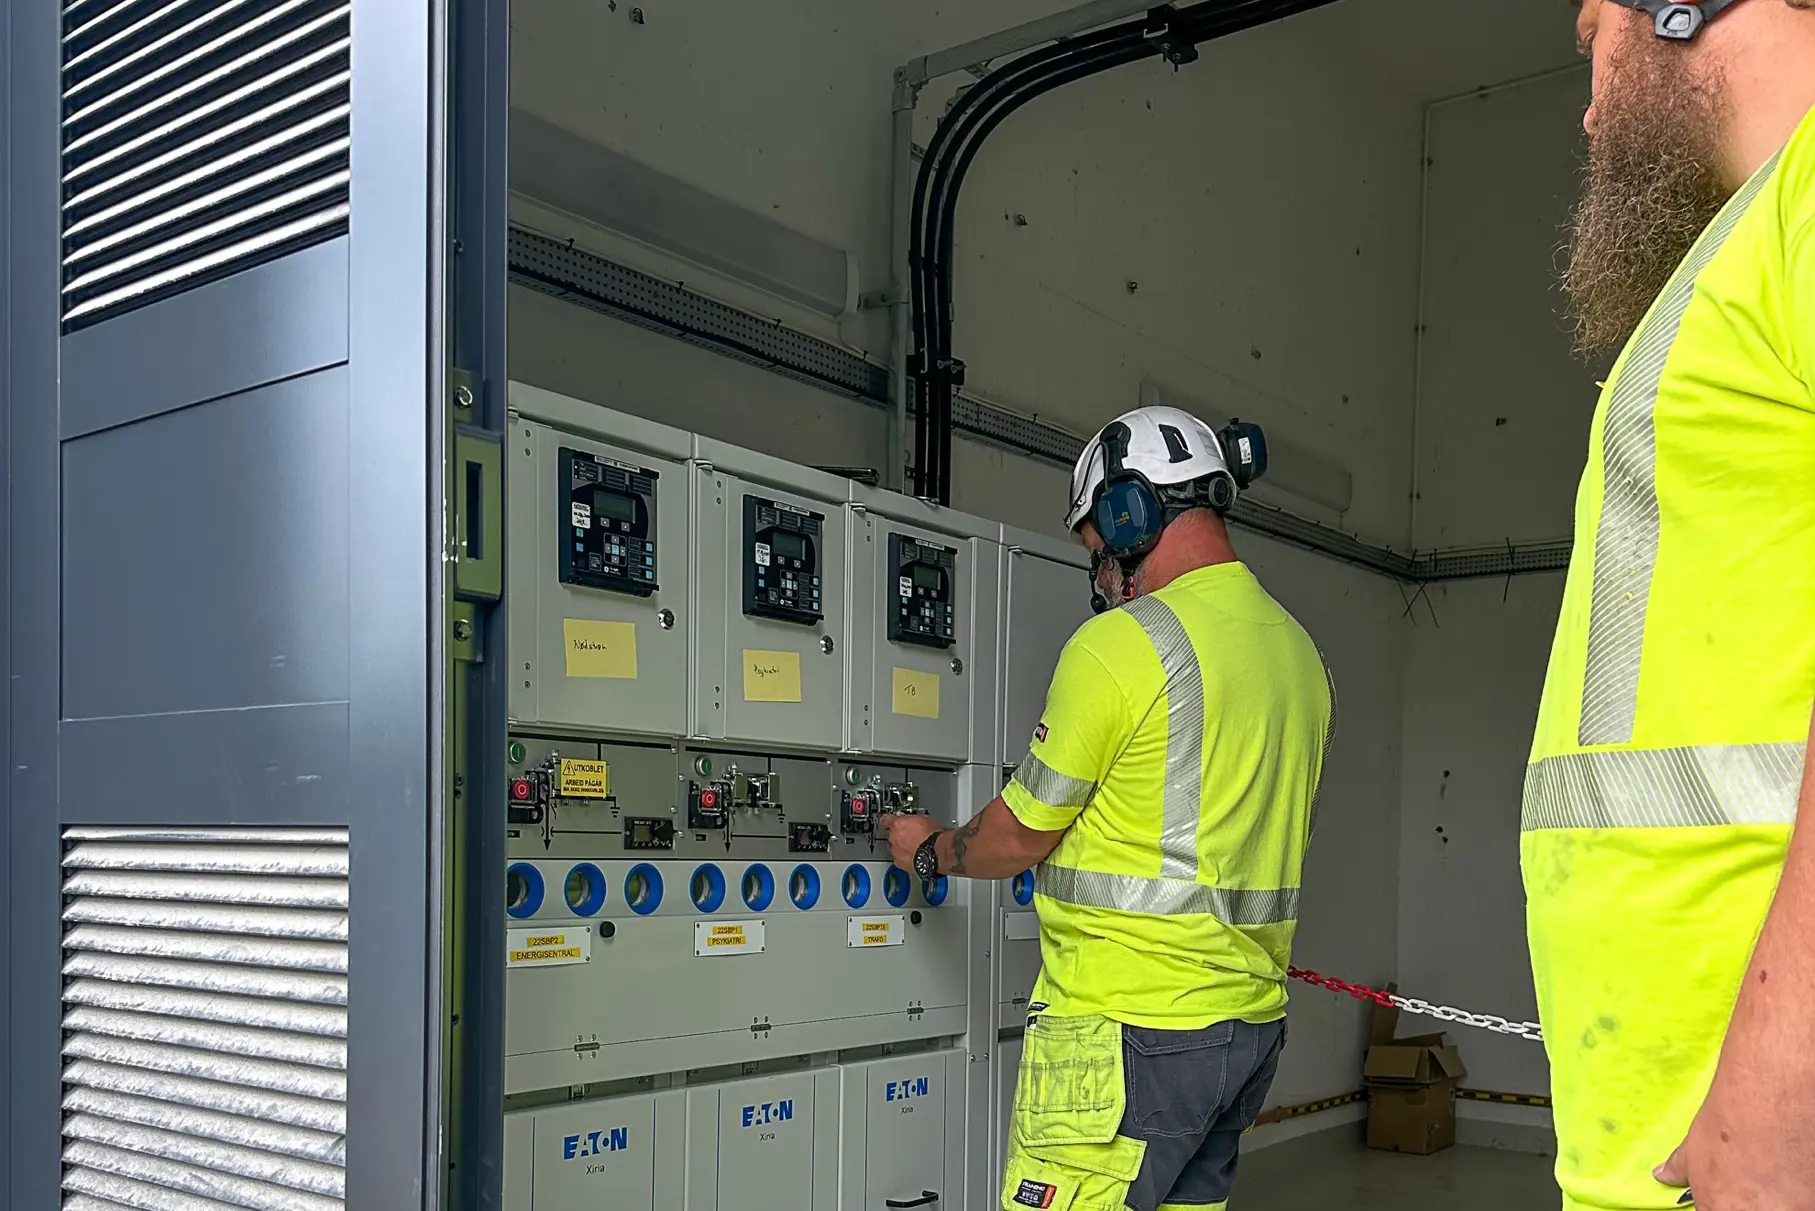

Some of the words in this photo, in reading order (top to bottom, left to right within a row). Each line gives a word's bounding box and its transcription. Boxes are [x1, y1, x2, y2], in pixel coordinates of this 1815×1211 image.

[574, 764, 604, 773] UTKOBLET
[533, 936, 559, 946] 22SBP2
[712, 936, 741, 945] PSYKIATRI
[516, 949, 574, 960] ENERGISENTRAL
[886, 1077, 928, 1101] EATON
[742, 1099, 793, 1127] EATON
[563, 1126, 628, 1160] EATON
[586, 1164, 605, 1175] Xiria
